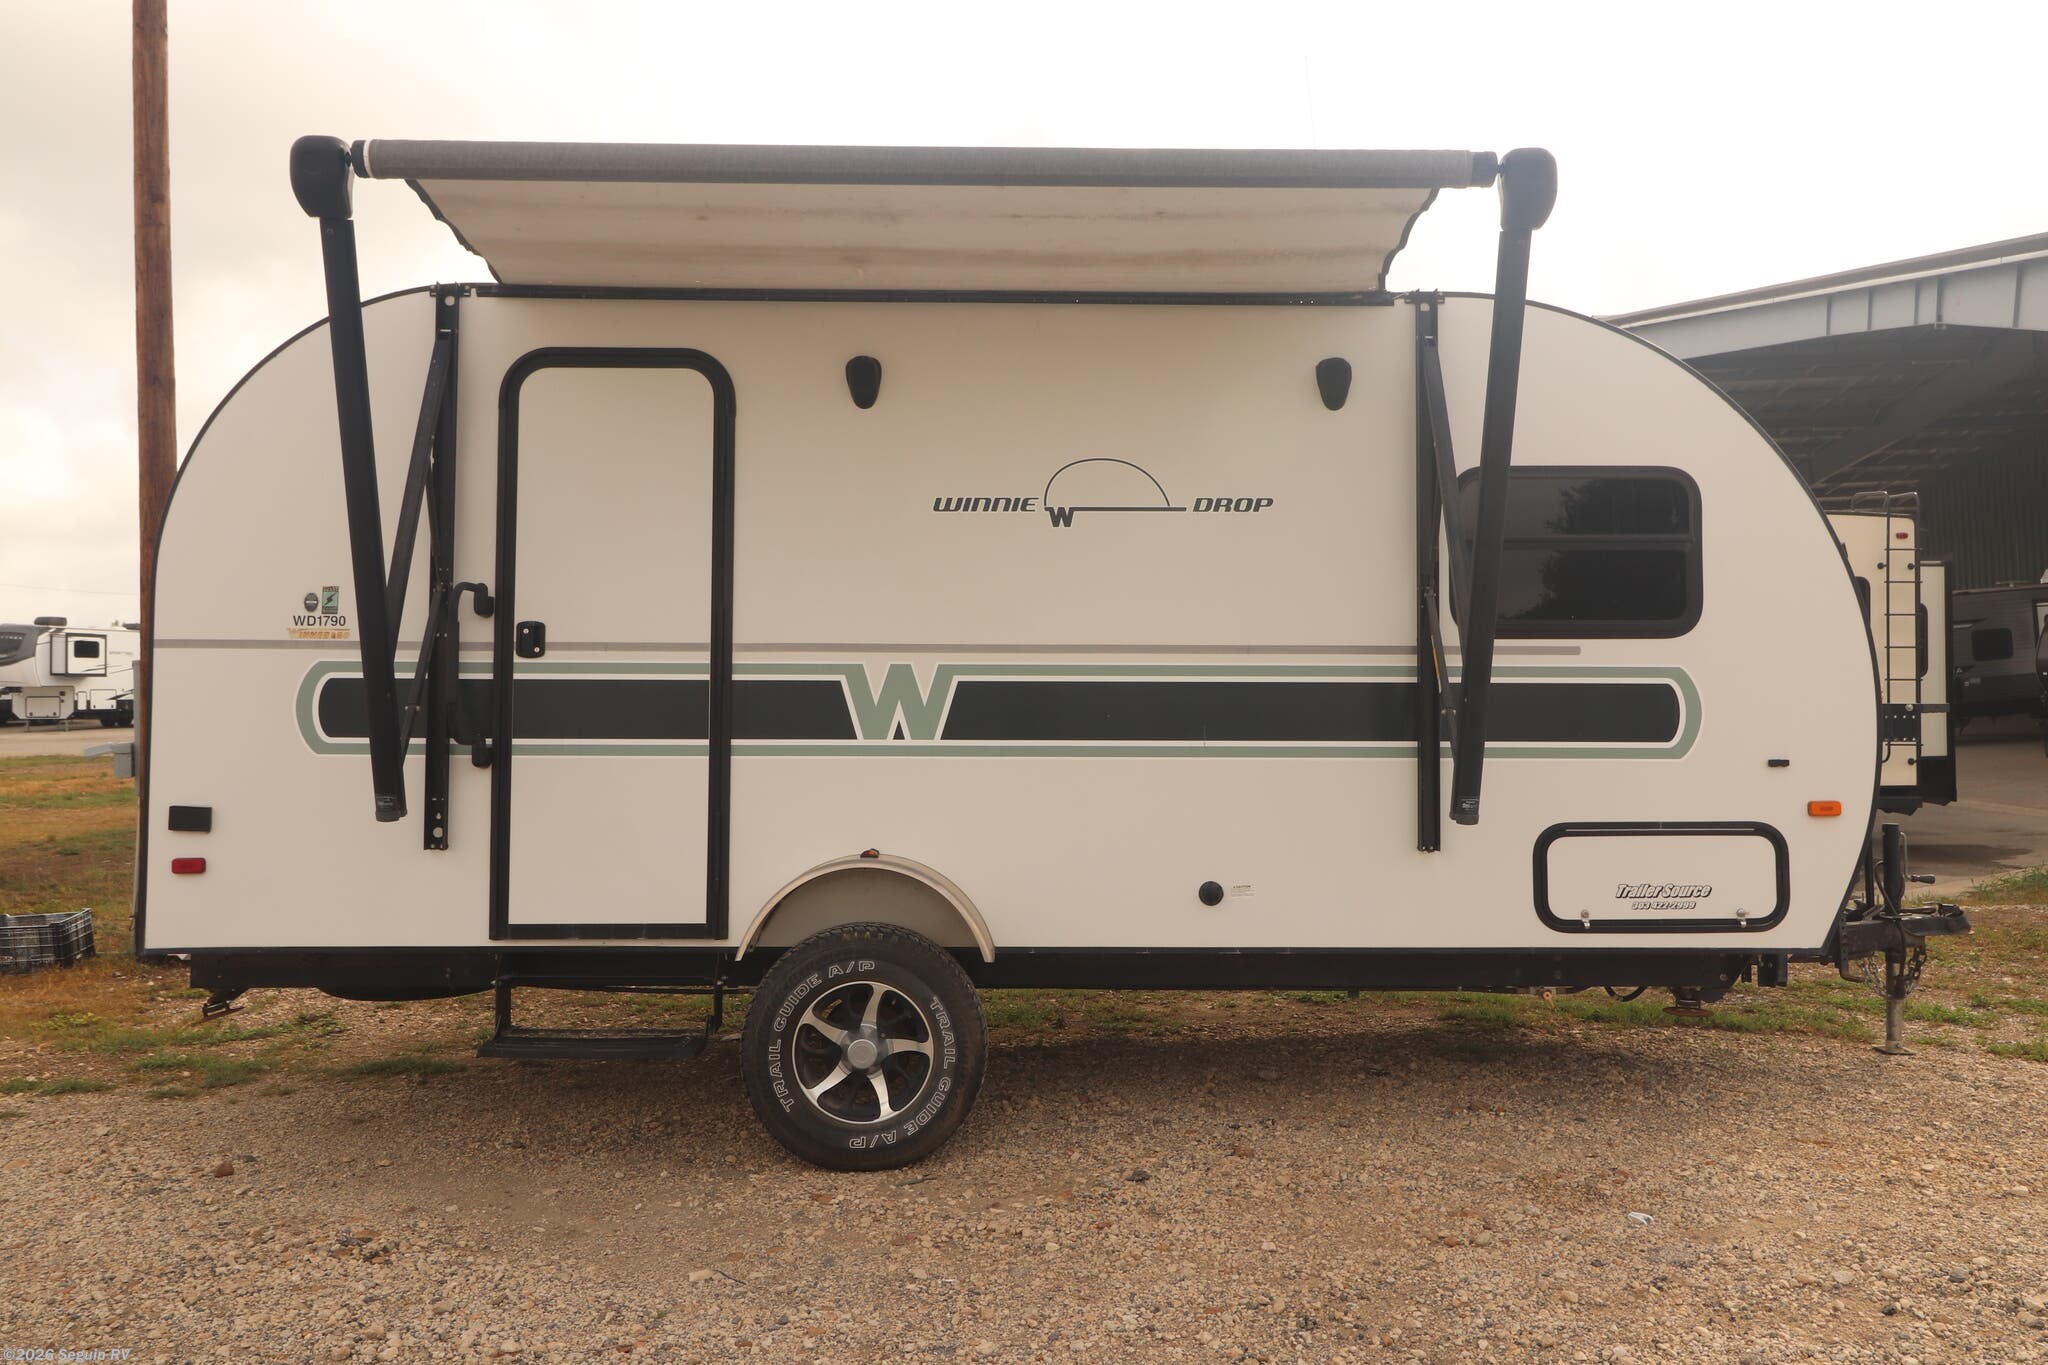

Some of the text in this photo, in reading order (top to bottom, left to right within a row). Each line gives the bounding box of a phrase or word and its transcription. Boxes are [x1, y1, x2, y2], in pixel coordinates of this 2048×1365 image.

[932, 497, 1274, 513] WINNIE DROP
[293, 615, 346, 627] WD1790
[845, 662, 958, 741] W
[1615, 882, 1713, 899] Trailer Source
[767, 960, 876, 1113] TRAIL GUIDE A/P
[849, 996, 957, 1149] TRAIL GUIDE A/P
